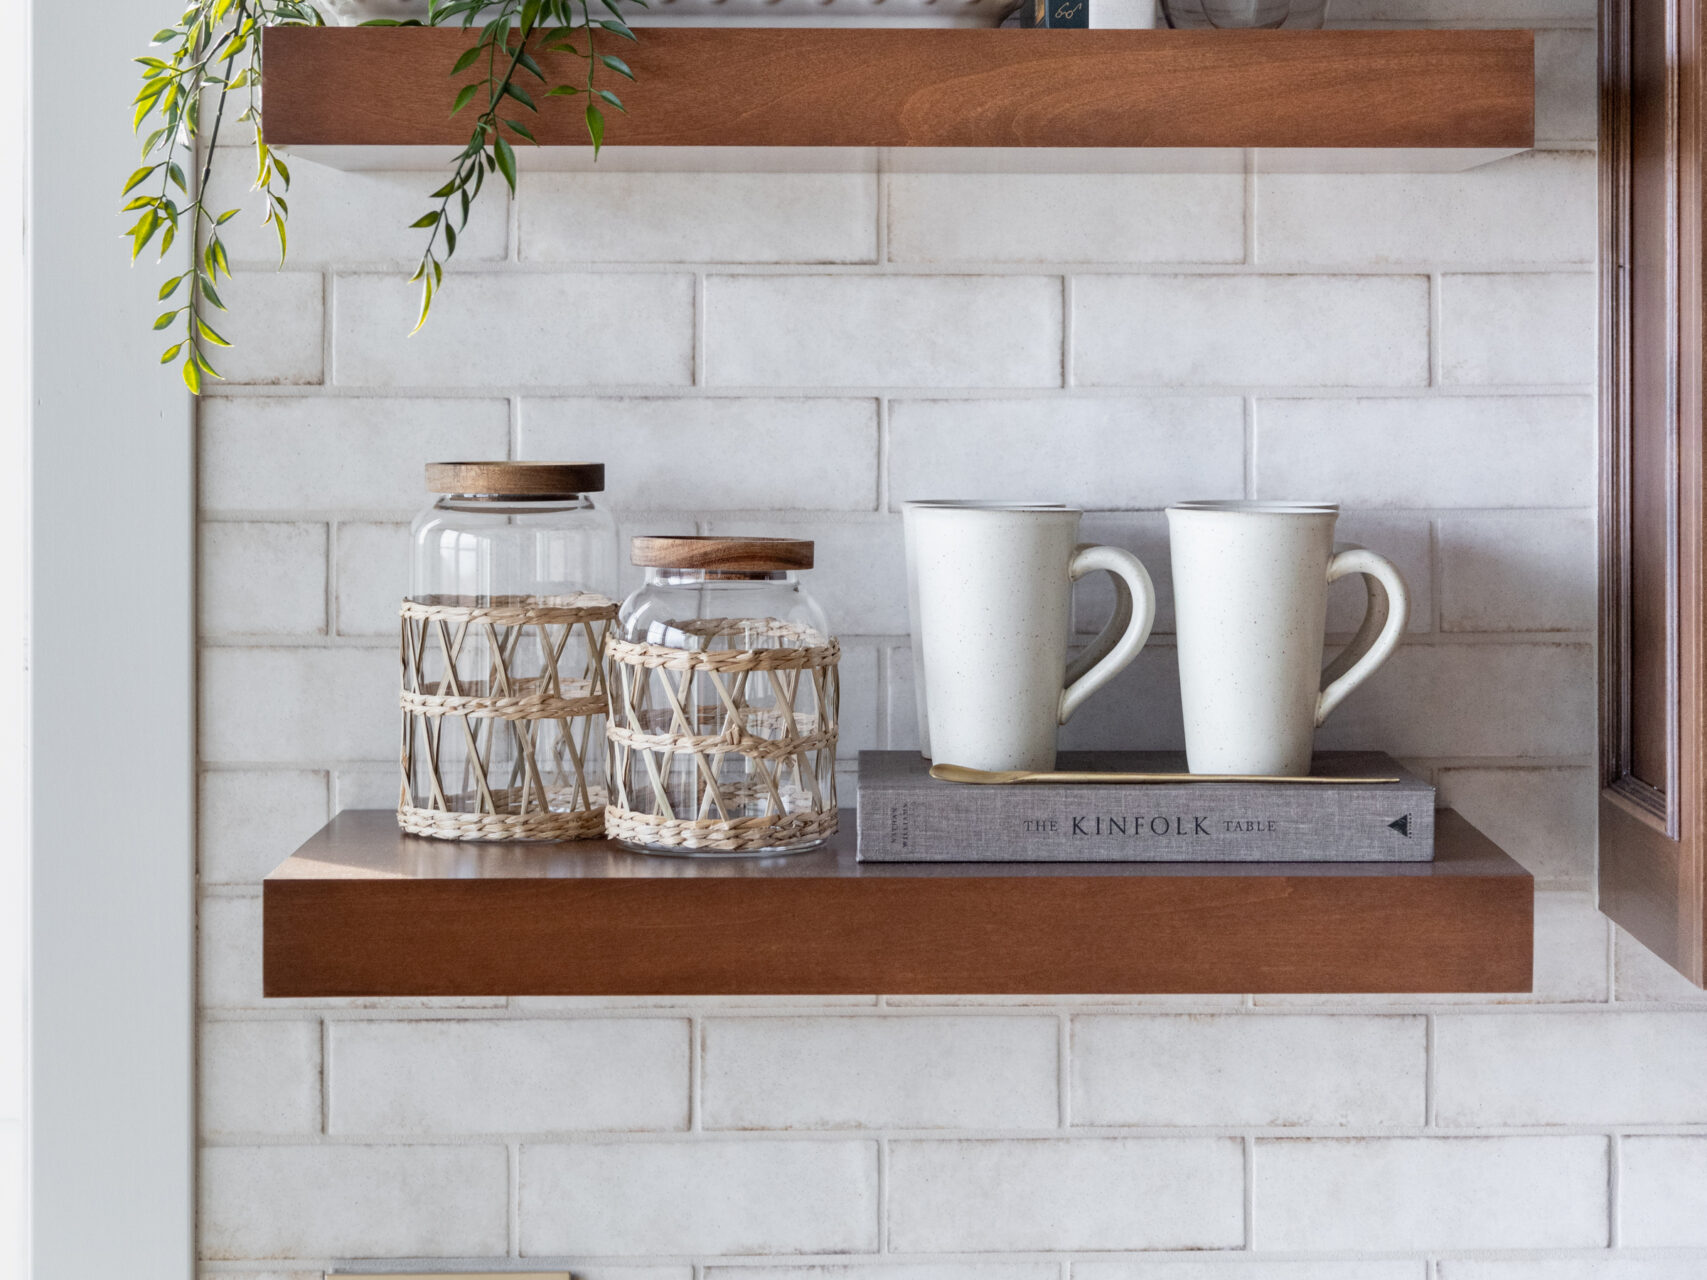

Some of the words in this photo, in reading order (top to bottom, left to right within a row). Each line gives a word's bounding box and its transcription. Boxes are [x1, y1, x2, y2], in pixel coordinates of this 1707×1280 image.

[1023, 820, 1058, 832] THE
[1071, 816, 1211, 836] KINFOLK
[1223, 820, 1277, 832] TABLE
